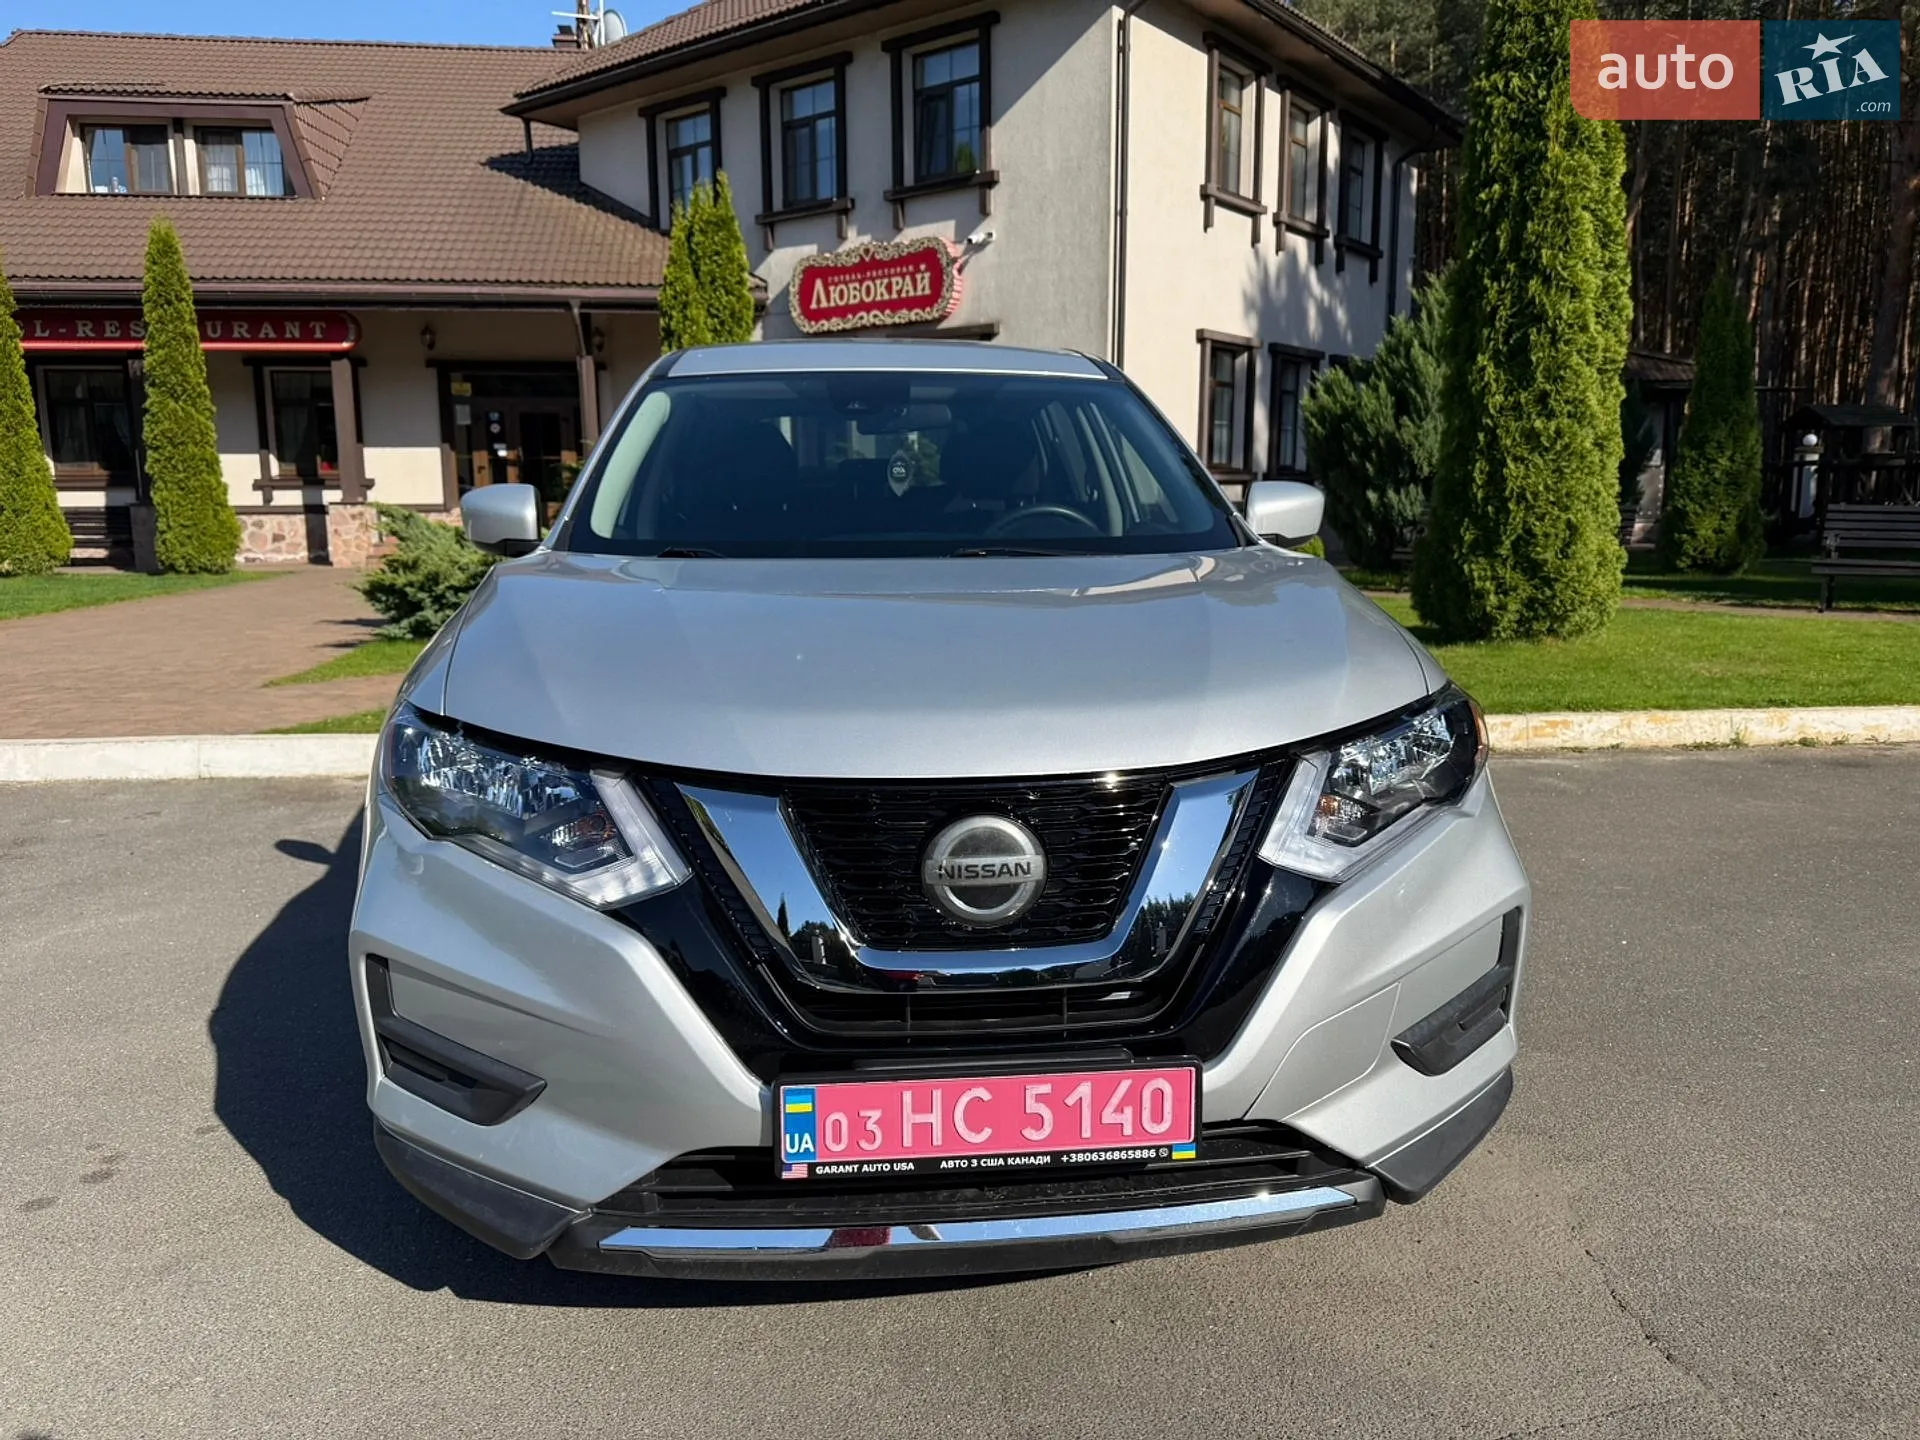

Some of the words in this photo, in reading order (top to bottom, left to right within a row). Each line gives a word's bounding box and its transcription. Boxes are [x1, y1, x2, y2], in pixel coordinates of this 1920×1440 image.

[809, 271, 931, 310] ЛЮБОКРАЙ
[937, 861, 1031, 880] NISSAN
[823, 1109, 883, 1152] 03
[1020, 1076, 1173, 1142] 5140
[785, 1132, 815, 1154] UA
[940, 1158, 968, 1169] АВТО
[980, 1157, 1005, 1168] США
[1007, 1155, 1051, 1167] КАНАДИ
[1060, 1149, 1156, 1164] +380636865886
[815, 1164, 859, 1175] GARANT
[861, 1163, 891, 1173] AUTO
[893, 1162, 915, 1172] USA
